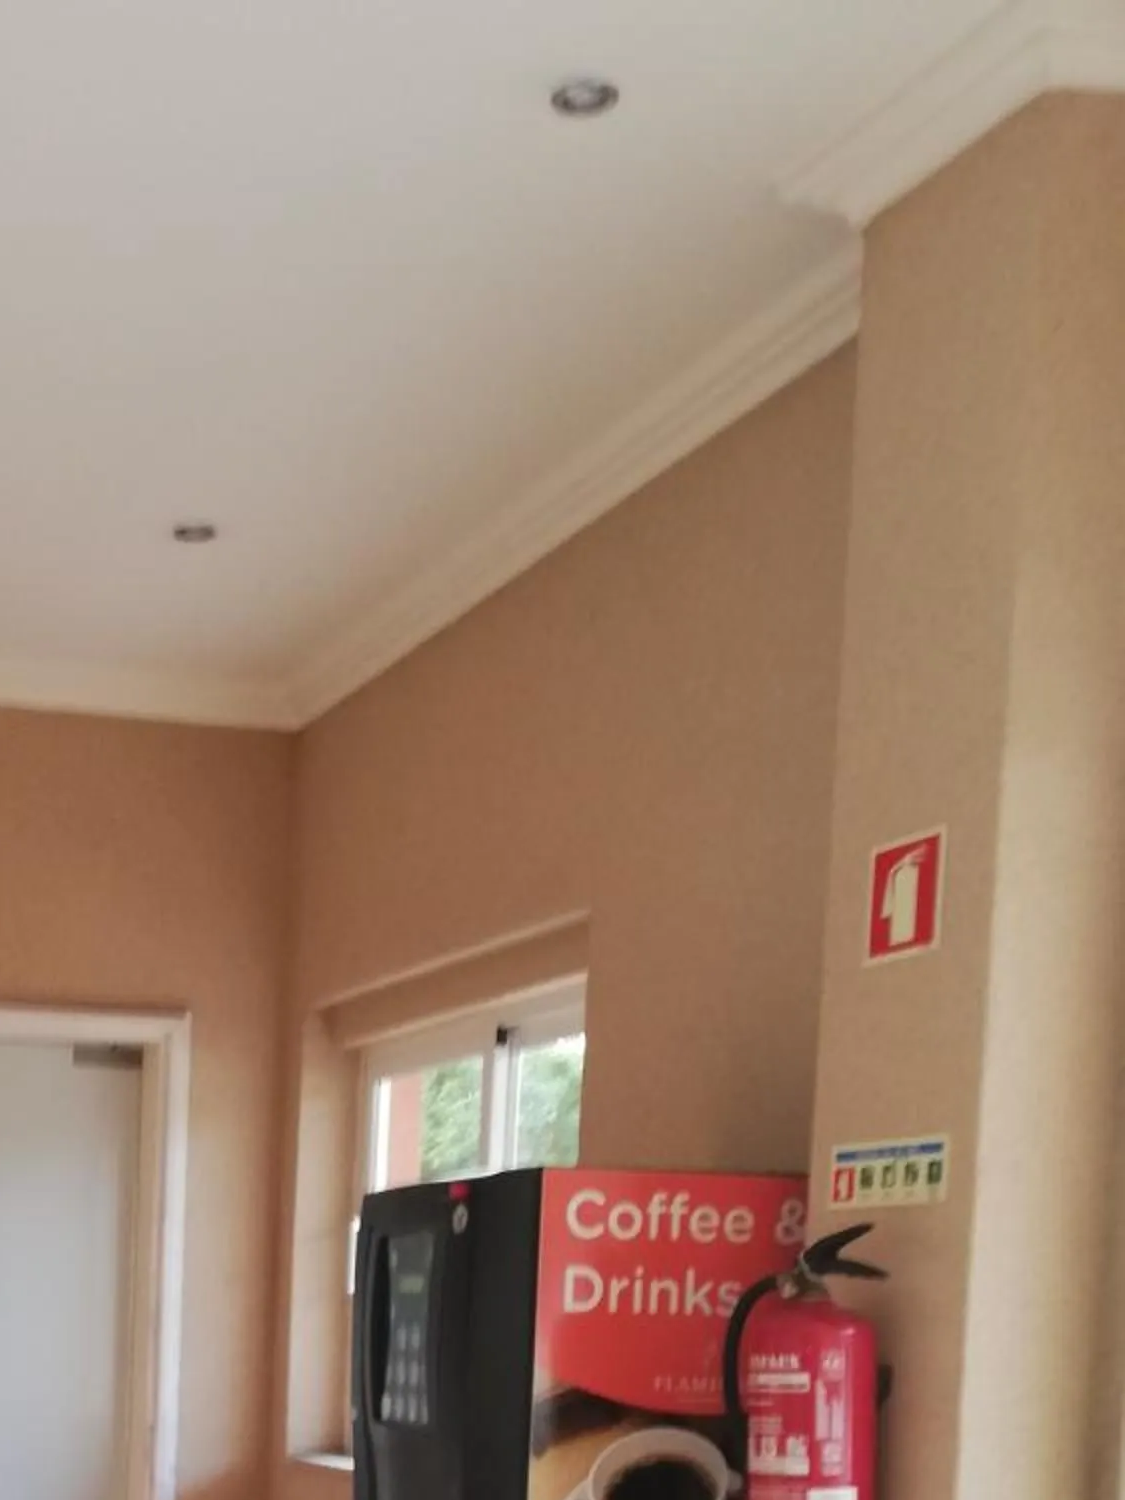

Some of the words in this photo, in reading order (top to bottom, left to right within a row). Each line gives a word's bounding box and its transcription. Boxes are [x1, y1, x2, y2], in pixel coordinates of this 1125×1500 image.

[565, 1188, 755, 1244] Coffee
[776, 1198, 806, 1245] &
[562, 1264, 742, 1319] Drinks
